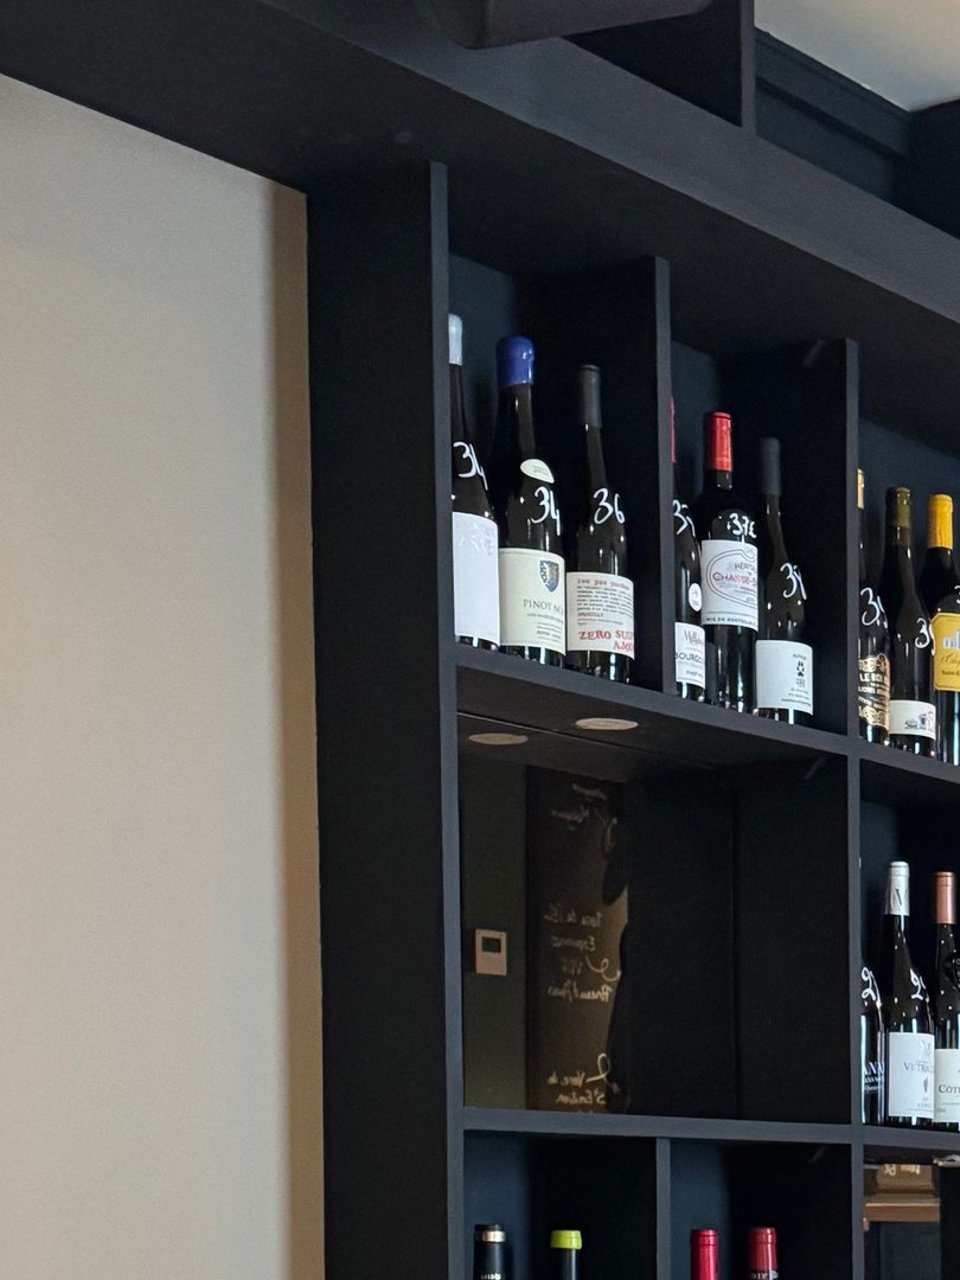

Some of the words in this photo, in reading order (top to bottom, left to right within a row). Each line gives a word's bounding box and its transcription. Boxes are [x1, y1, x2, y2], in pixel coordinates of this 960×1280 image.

[593, 487, 625, 524] 36
[523, 600, 551, 611] PINOT
[578, 629, 612, 641] ZERO
